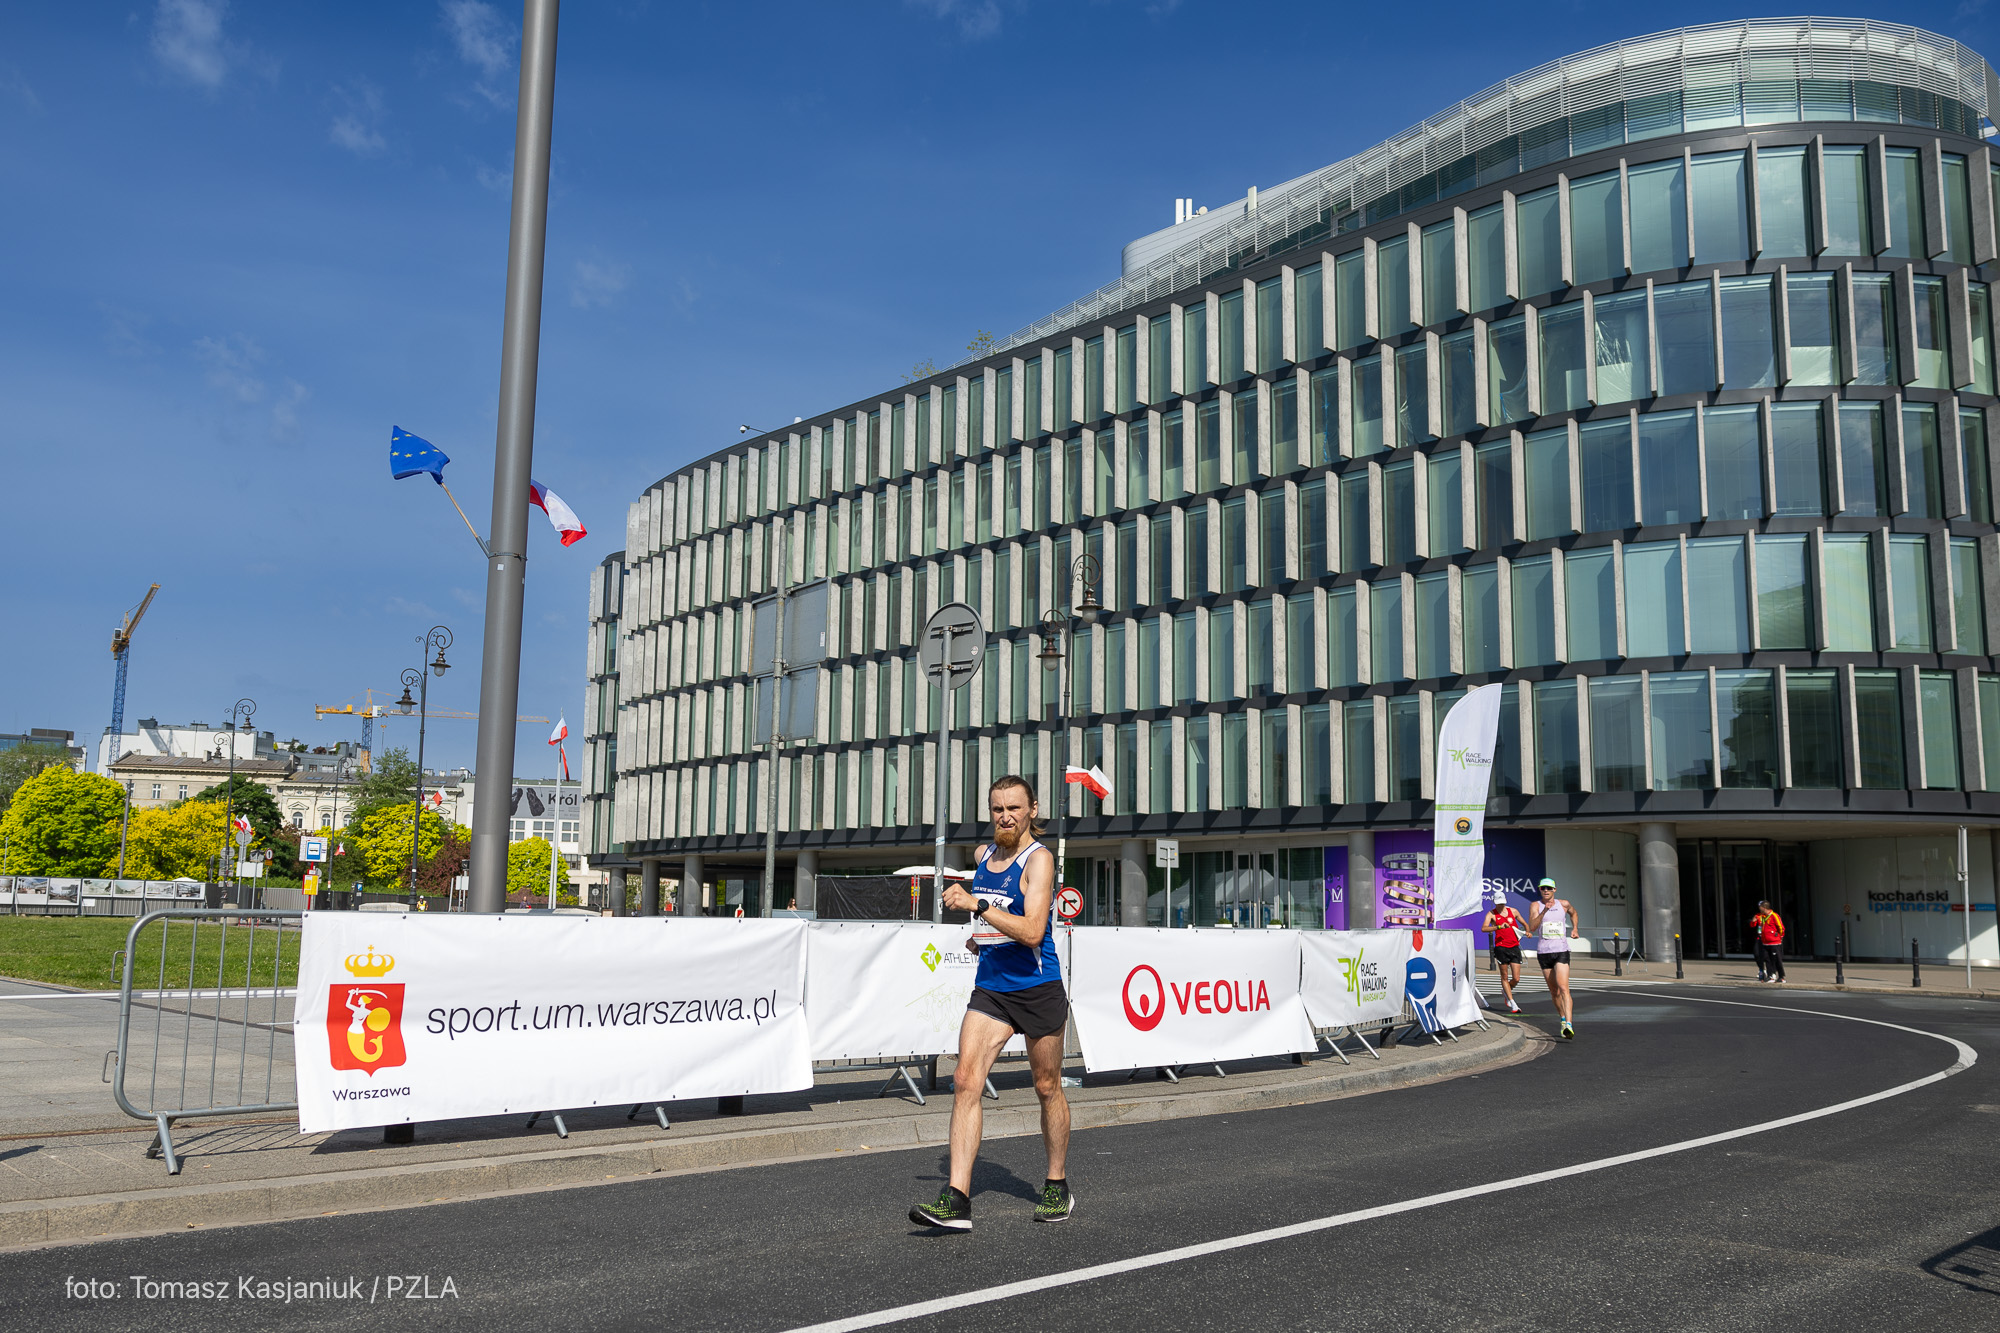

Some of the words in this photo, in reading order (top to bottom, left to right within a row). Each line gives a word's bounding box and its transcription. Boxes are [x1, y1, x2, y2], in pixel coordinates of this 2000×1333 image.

[548, 793, 578, 806] Król
[1599, 883, 1626, 900] CCC
[1868, 890, 1949, 902] kochański
[992, 897, 1004, 908] 64
[1360, 962, 1378, 977] RACE
[1361, 977, 1388, 992] WALKING
[1170, 979, 1271, 1015] VEOLIA
[1362, 993, 1379, 1003] WARSAW
[1379, 991, 1387, 1001] CUP
[426, 989, 777, 1040] sport.um.warszawa.pl
[332, 1086, 411, 1101] Warszawa
